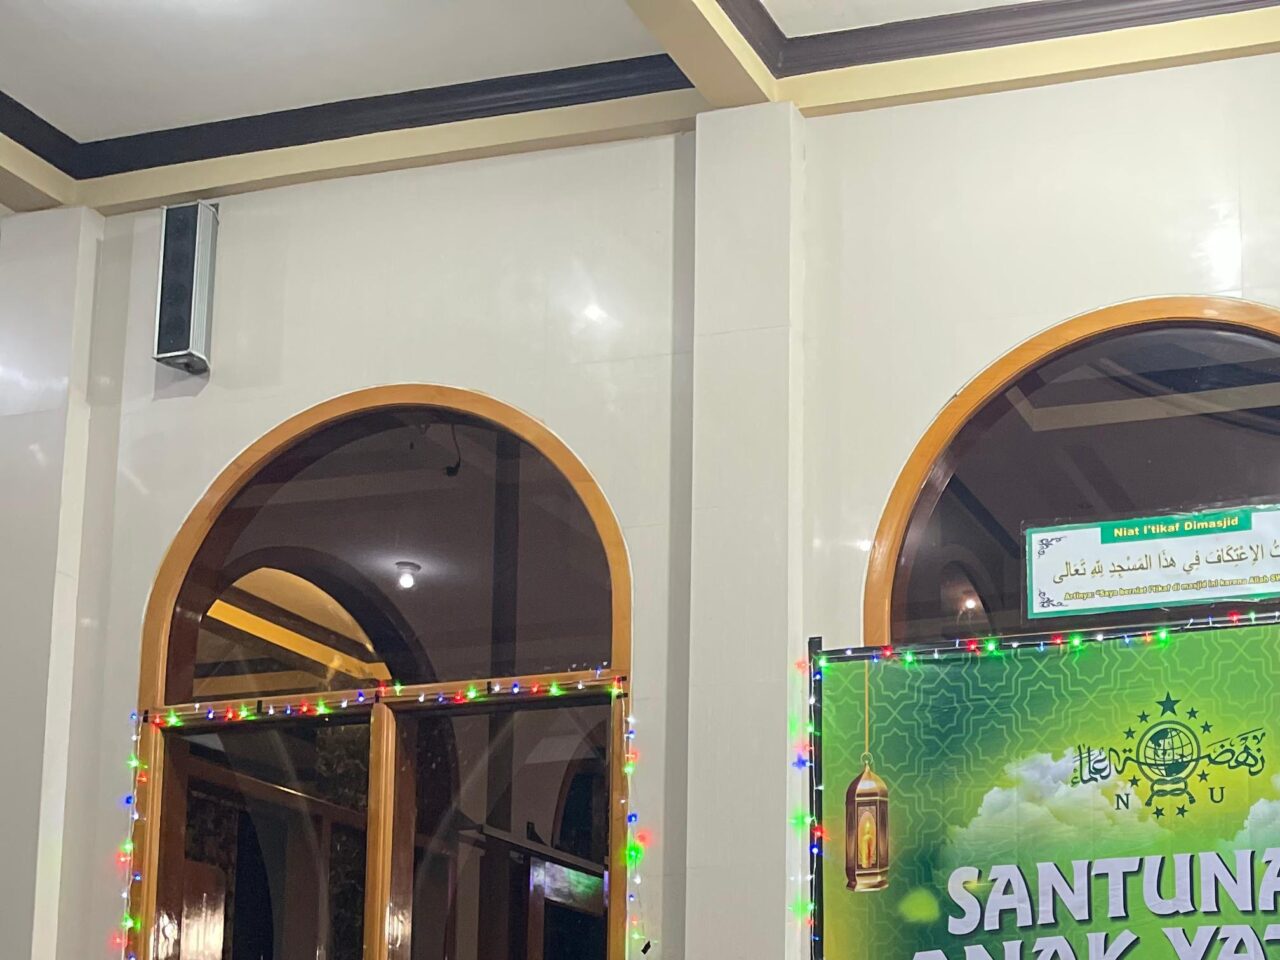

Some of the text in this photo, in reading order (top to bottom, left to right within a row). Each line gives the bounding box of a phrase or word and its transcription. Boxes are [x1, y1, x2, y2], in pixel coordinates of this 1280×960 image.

[1113, 527, 1140, 538] Niat
[1184, 516, 1239, 531] Dimasjid
[1119, 586, 1147, 596] berniat
[1172, 584, 1180, 592] di
[1181, 580, 1208, 591] masjid
[1208, 579, 1219, 588] ini
[1220, 578, 1247, 586] karena
[1248, 575, 1270, 584] Allah
[1115, 793, 1130, 810] N
[1208, 786, 1225, 804] U
